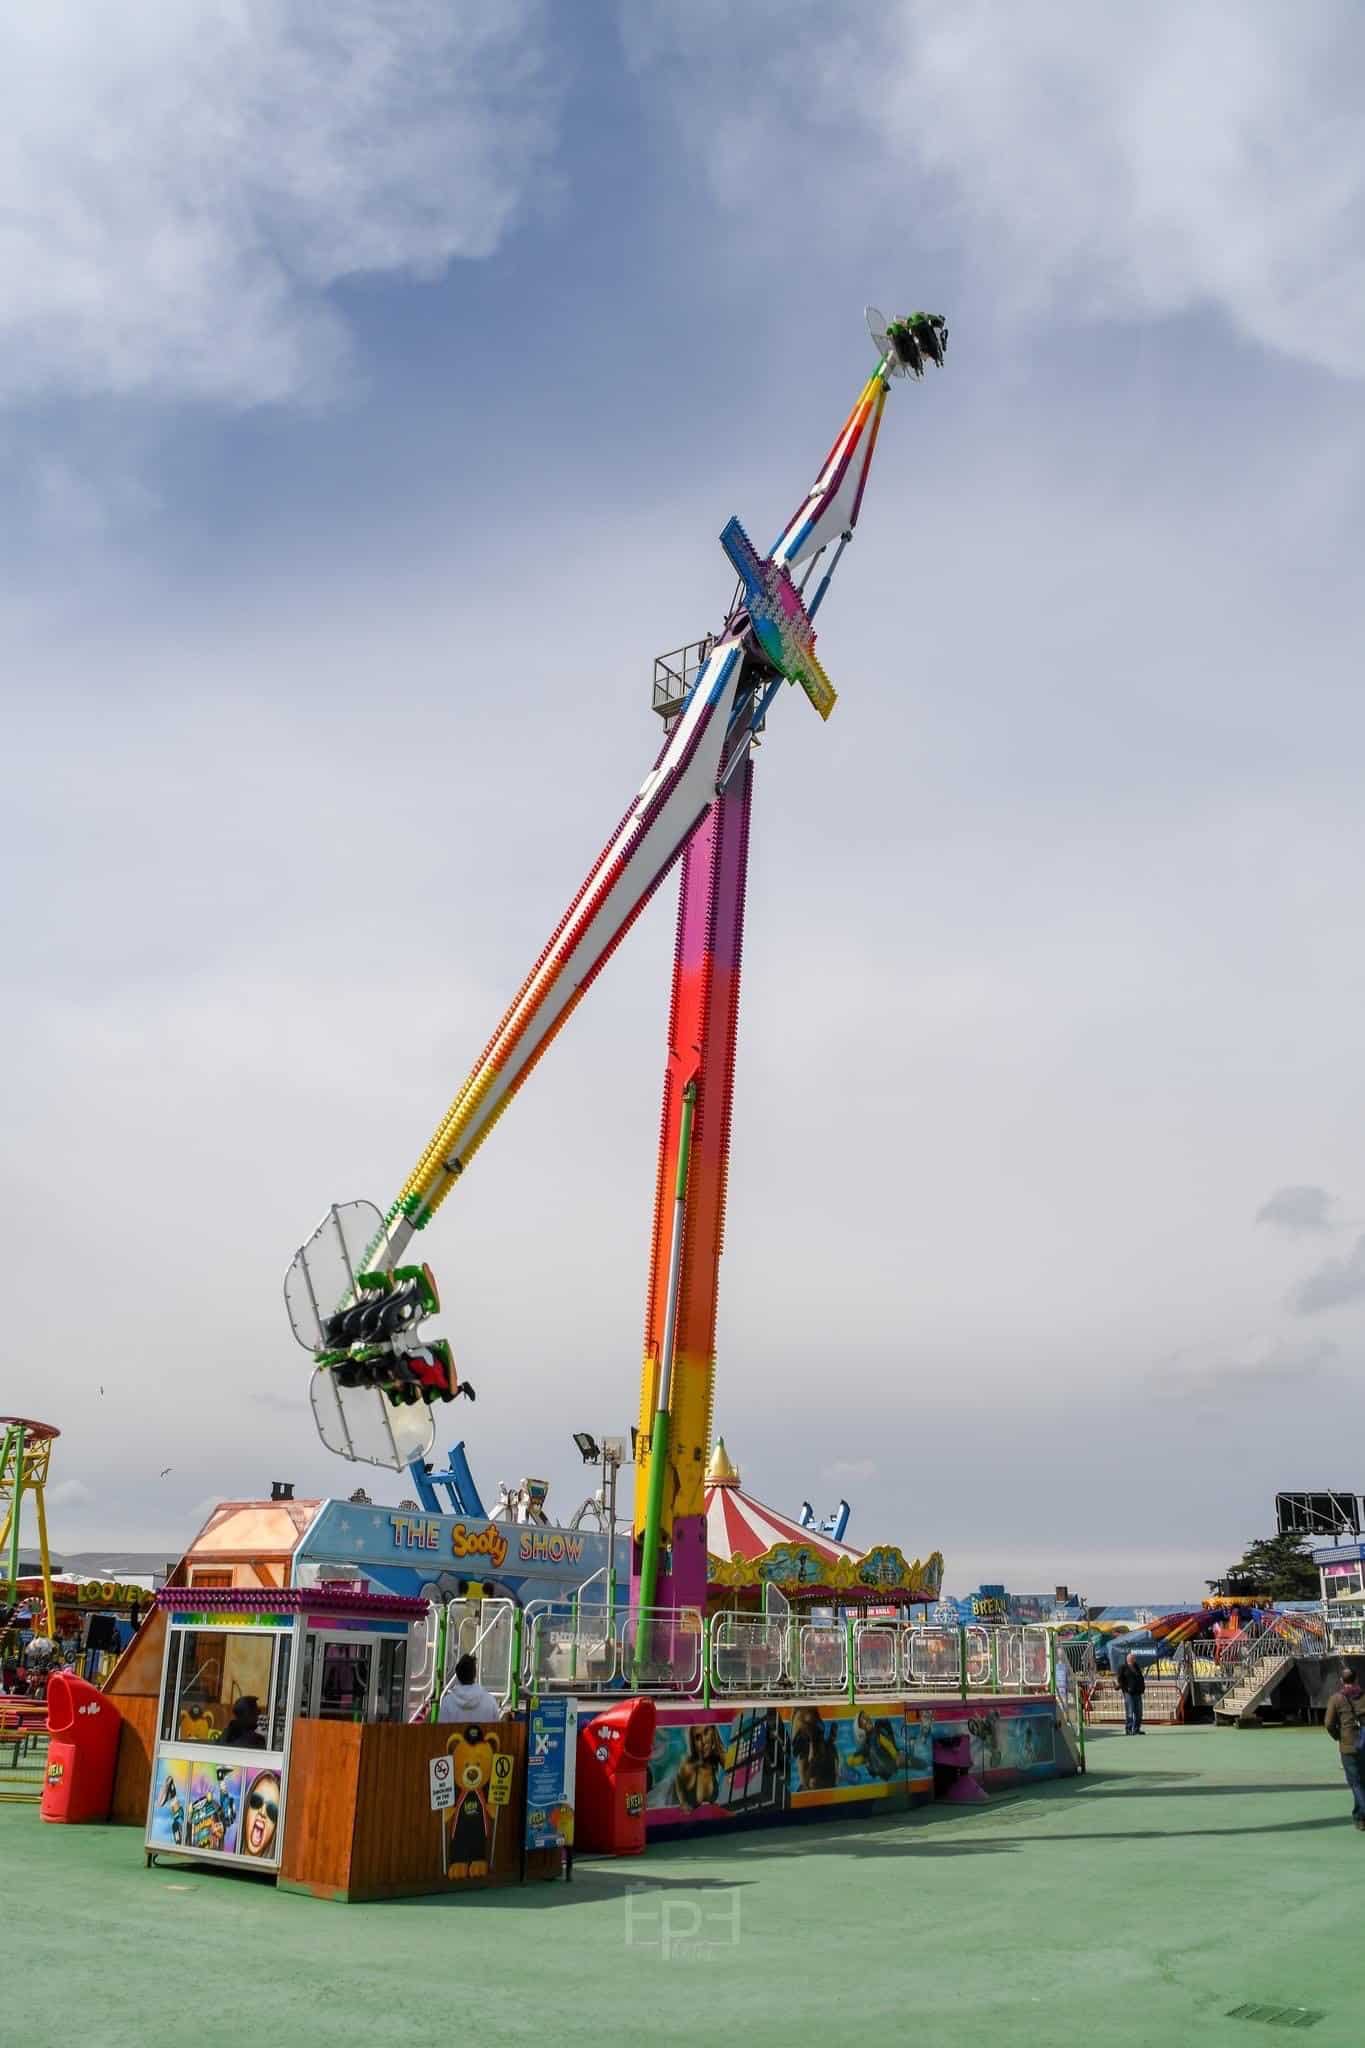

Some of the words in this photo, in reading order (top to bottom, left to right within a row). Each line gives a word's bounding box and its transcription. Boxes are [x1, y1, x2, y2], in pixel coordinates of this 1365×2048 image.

[390, 1515, 441, 1551] THE
[452, 1522, 509, 1569] Sooty
[519, 1531, 585, 1564] SHOW
